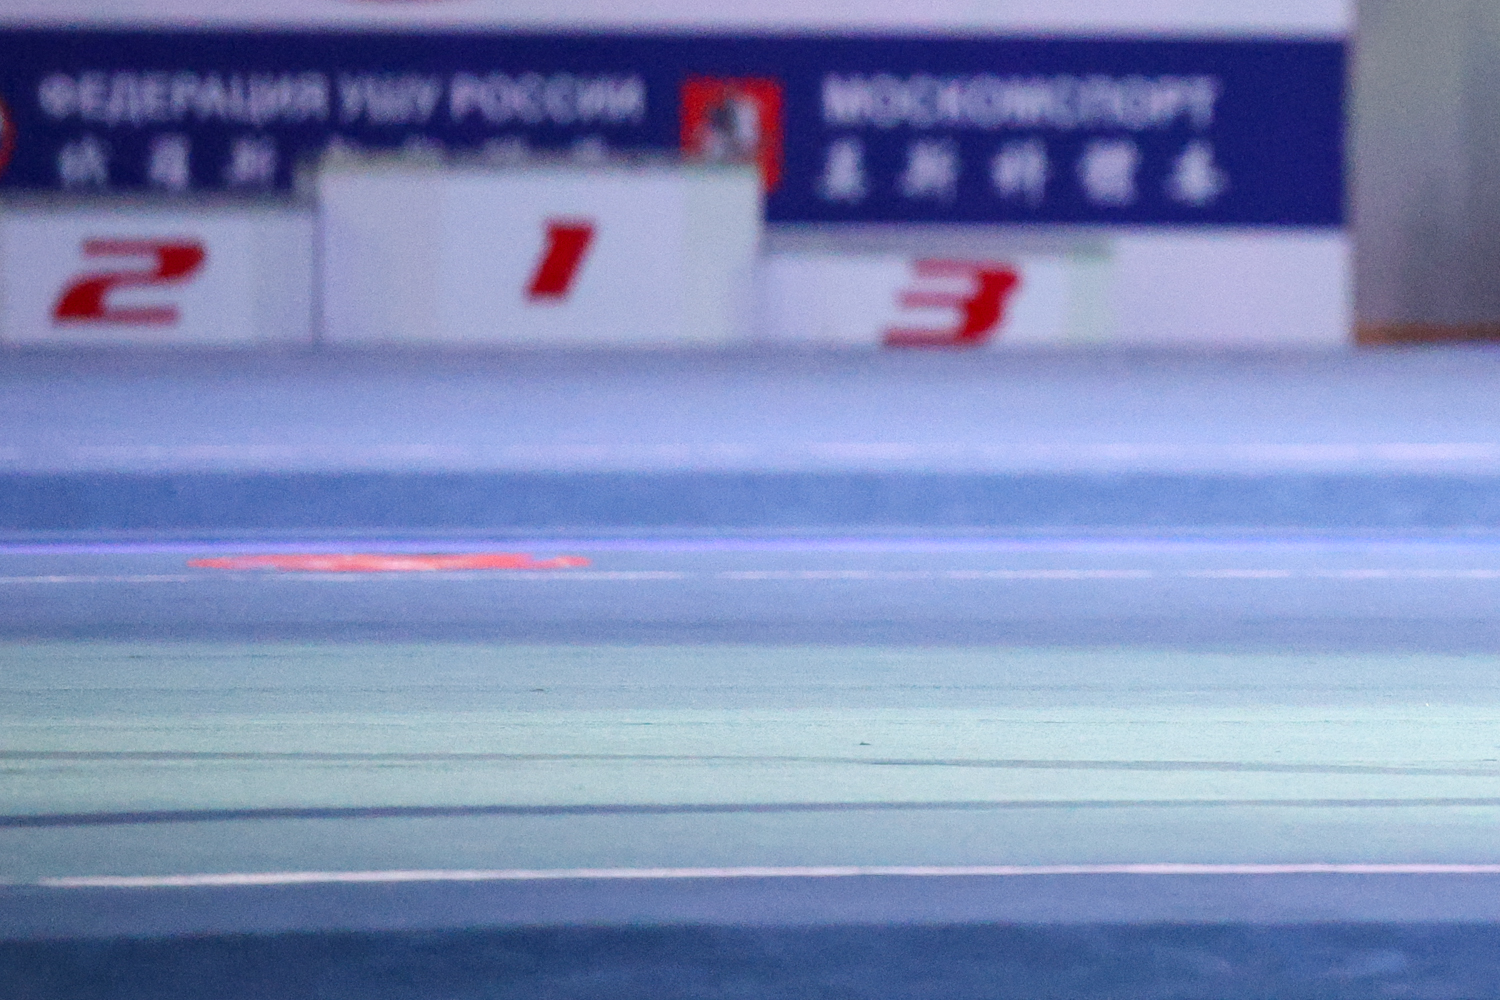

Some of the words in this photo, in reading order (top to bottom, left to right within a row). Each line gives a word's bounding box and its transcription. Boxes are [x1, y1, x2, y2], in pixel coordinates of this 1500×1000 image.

[38, 72, 329, 125] ФЕДЕРАЦИЯ
[338, 74, 441, 122] УШУ
[448, 73, 644, 122] РОССИИ
[822, 75, 1216, 125] МОСКОМСПОРТ
[50, 238, 206, 326] 2
[525, 219, 595, 302] 1
[883, 258, 1020, 349] 3
